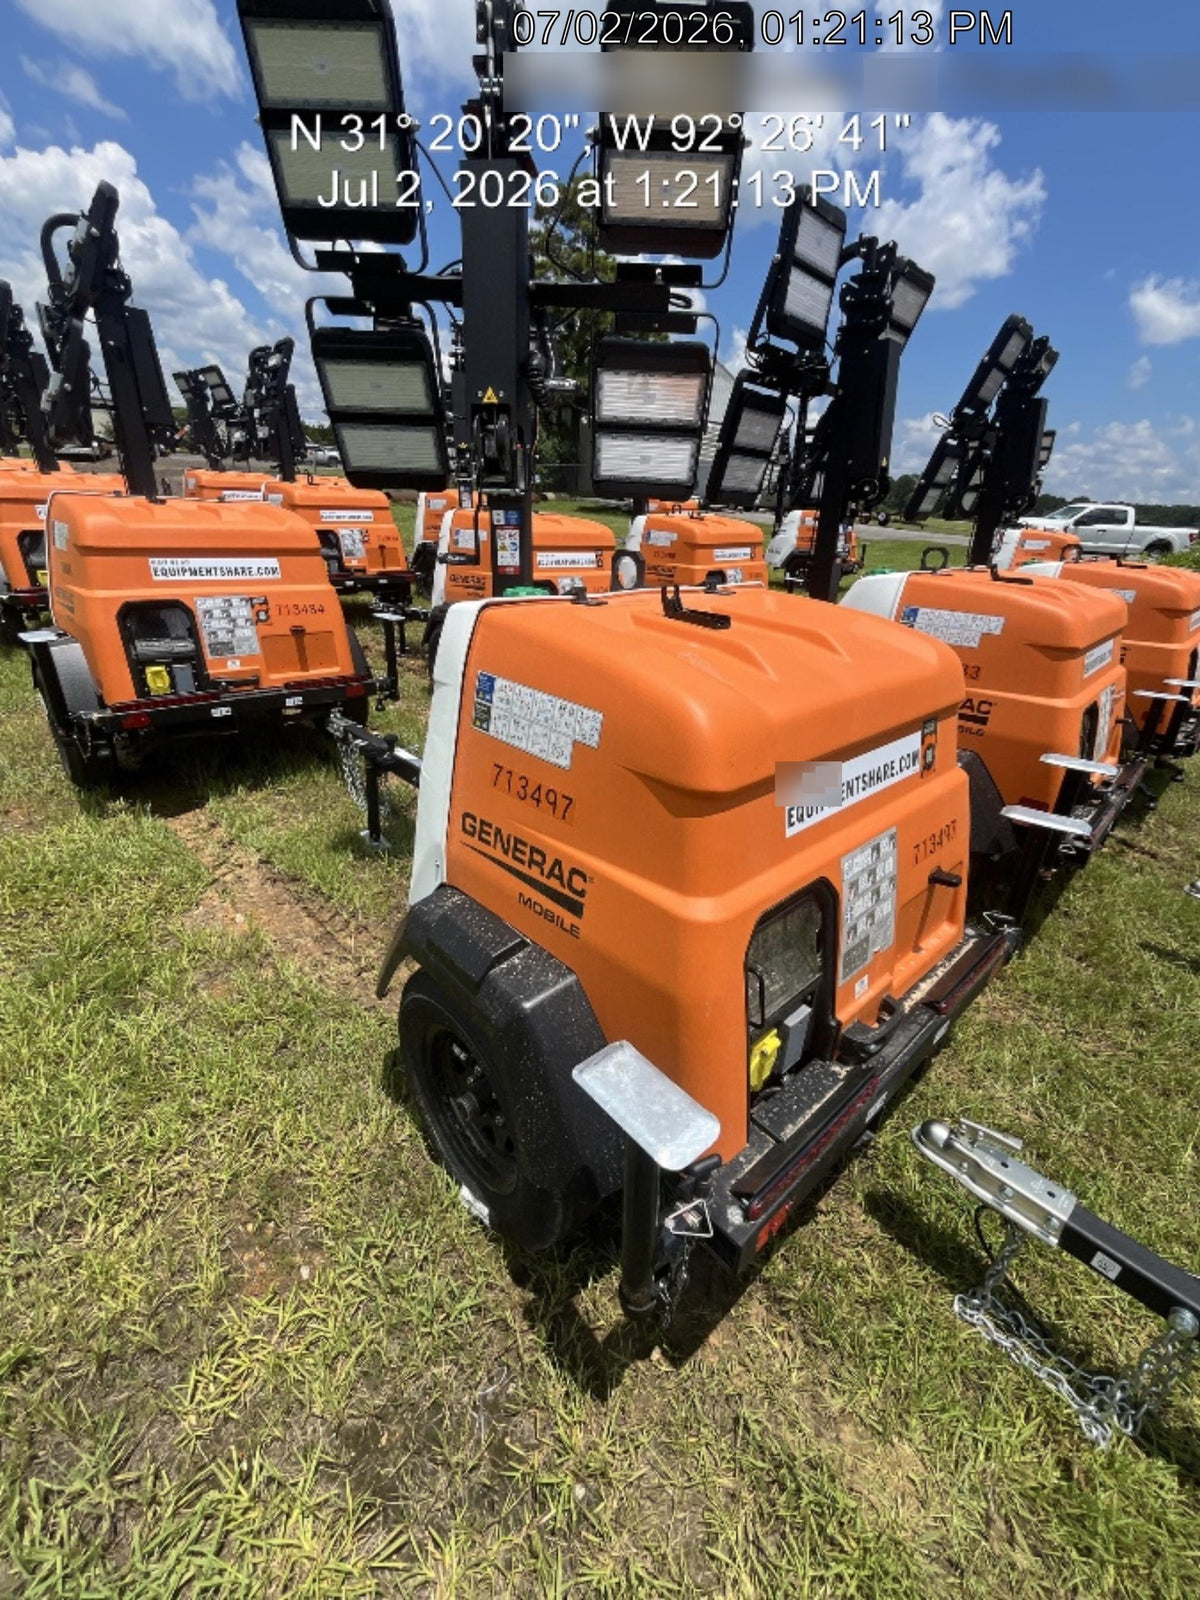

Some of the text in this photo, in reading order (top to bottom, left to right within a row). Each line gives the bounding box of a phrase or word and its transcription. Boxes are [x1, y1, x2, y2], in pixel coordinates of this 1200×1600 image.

[493, 763, 574, 821] 713497
[461, 811, 588, 899] GENERAC
[912, 818, 958, 865] 713497
[518, 892, 581, 940] MOBILE
